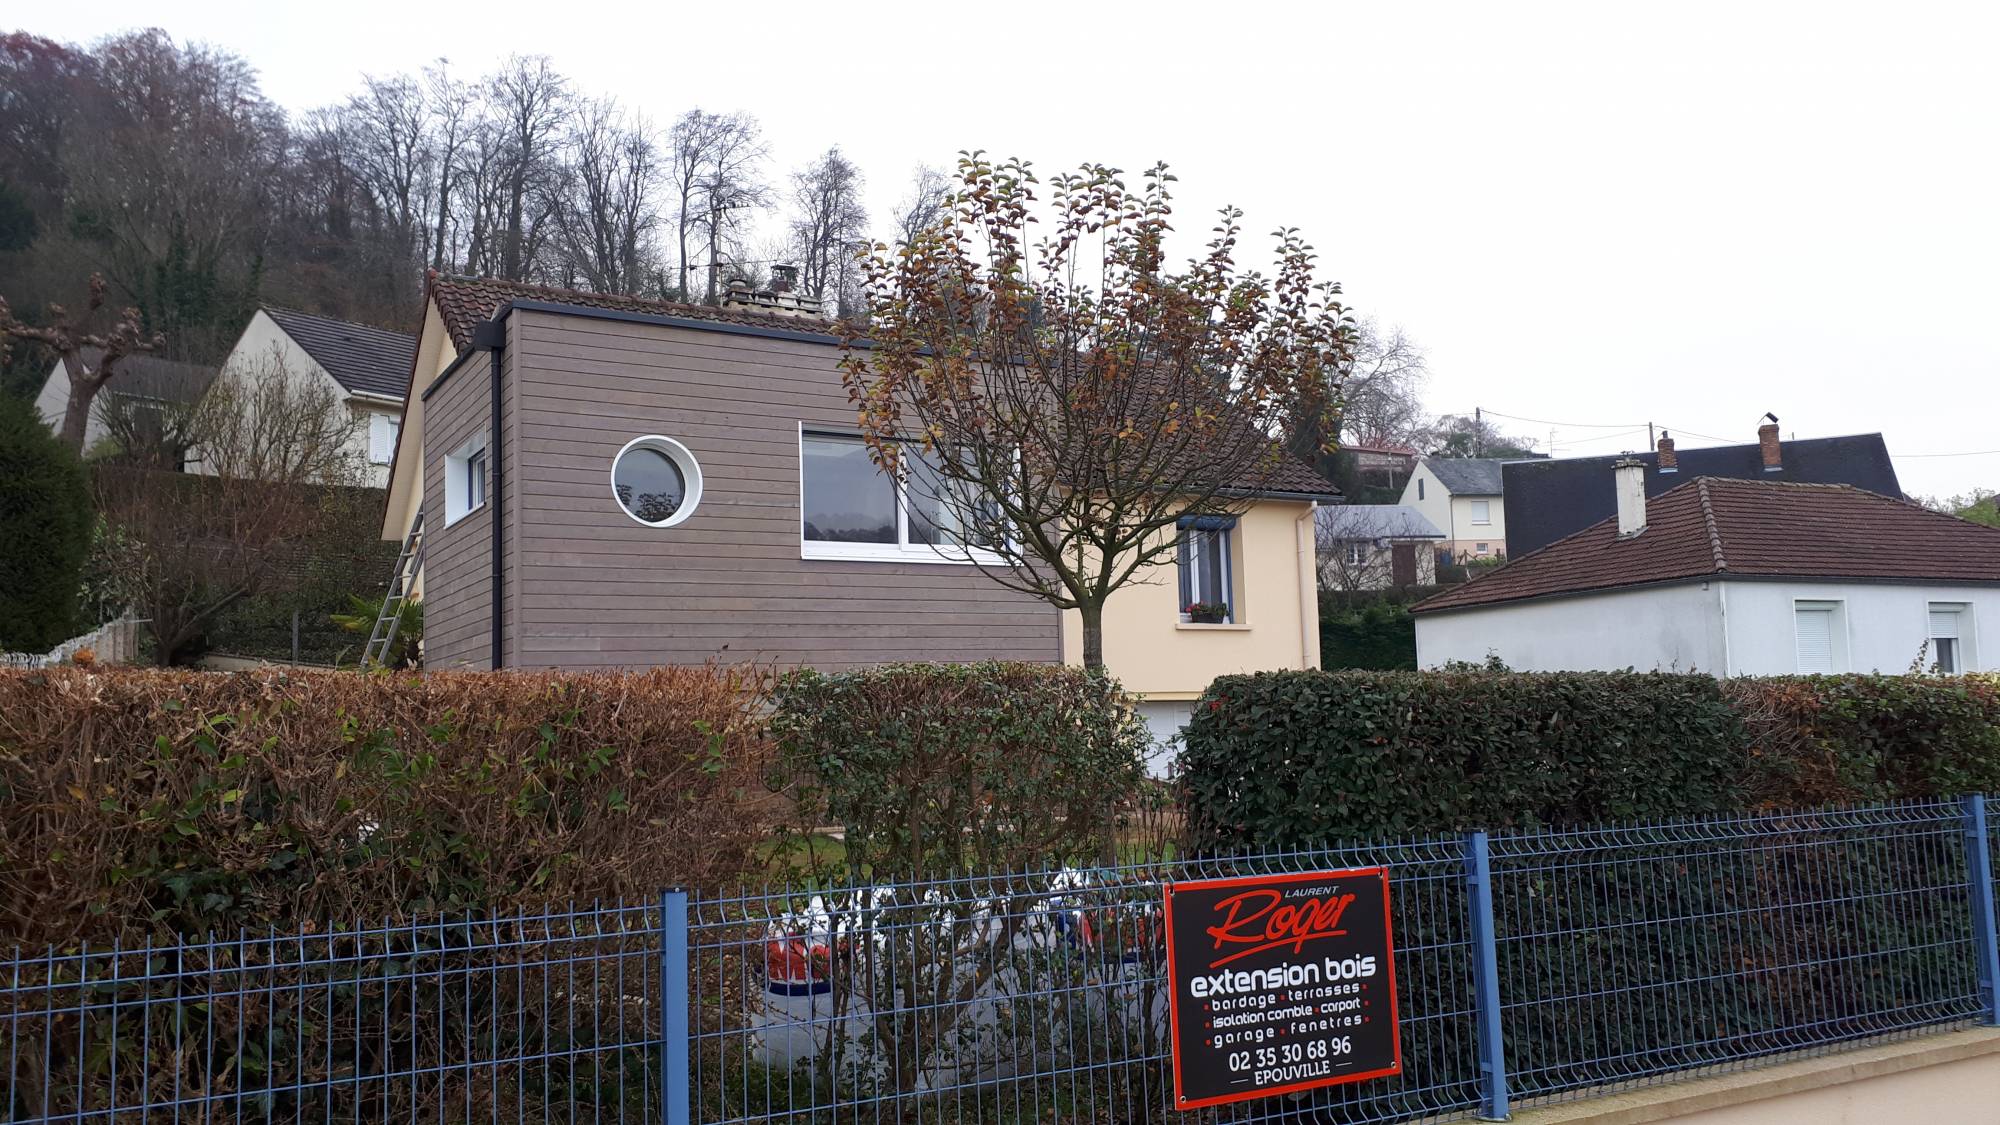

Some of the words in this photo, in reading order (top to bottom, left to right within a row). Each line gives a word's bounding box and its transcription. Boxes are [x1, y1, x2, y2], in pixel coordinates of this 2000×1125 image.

[1284, 885, 1339, 898] LAURENT
[1206, 889, 1356, 954] Roger
[1190, 961, 1320, 998] extension
[1325, 953, 1376, 981] bois
[1212, 993, 1276, 1012] bardage
[1288, 982, 1360, 1001] terrasses
[1213, 1011, 1265, 1029] isolation
[1267, 1005, 1313, 1021] comble
[1320, 997, 1361, 1014] carport
[1214, 1028, 1275, 1048] garage
[1290, 1014, 1362, 1034] fenetres
[1228, 1051, 1251, 1072] 02
[1256, 1047, 1277, 1068] 35
[1281, 1043, 1302, 1063] 30
[1307, 1039, 1327, 1060] 68
[1331, 1035, 1352, 1055] 96
[1254, 1060, 1331, 1085] EPOUVILLE
